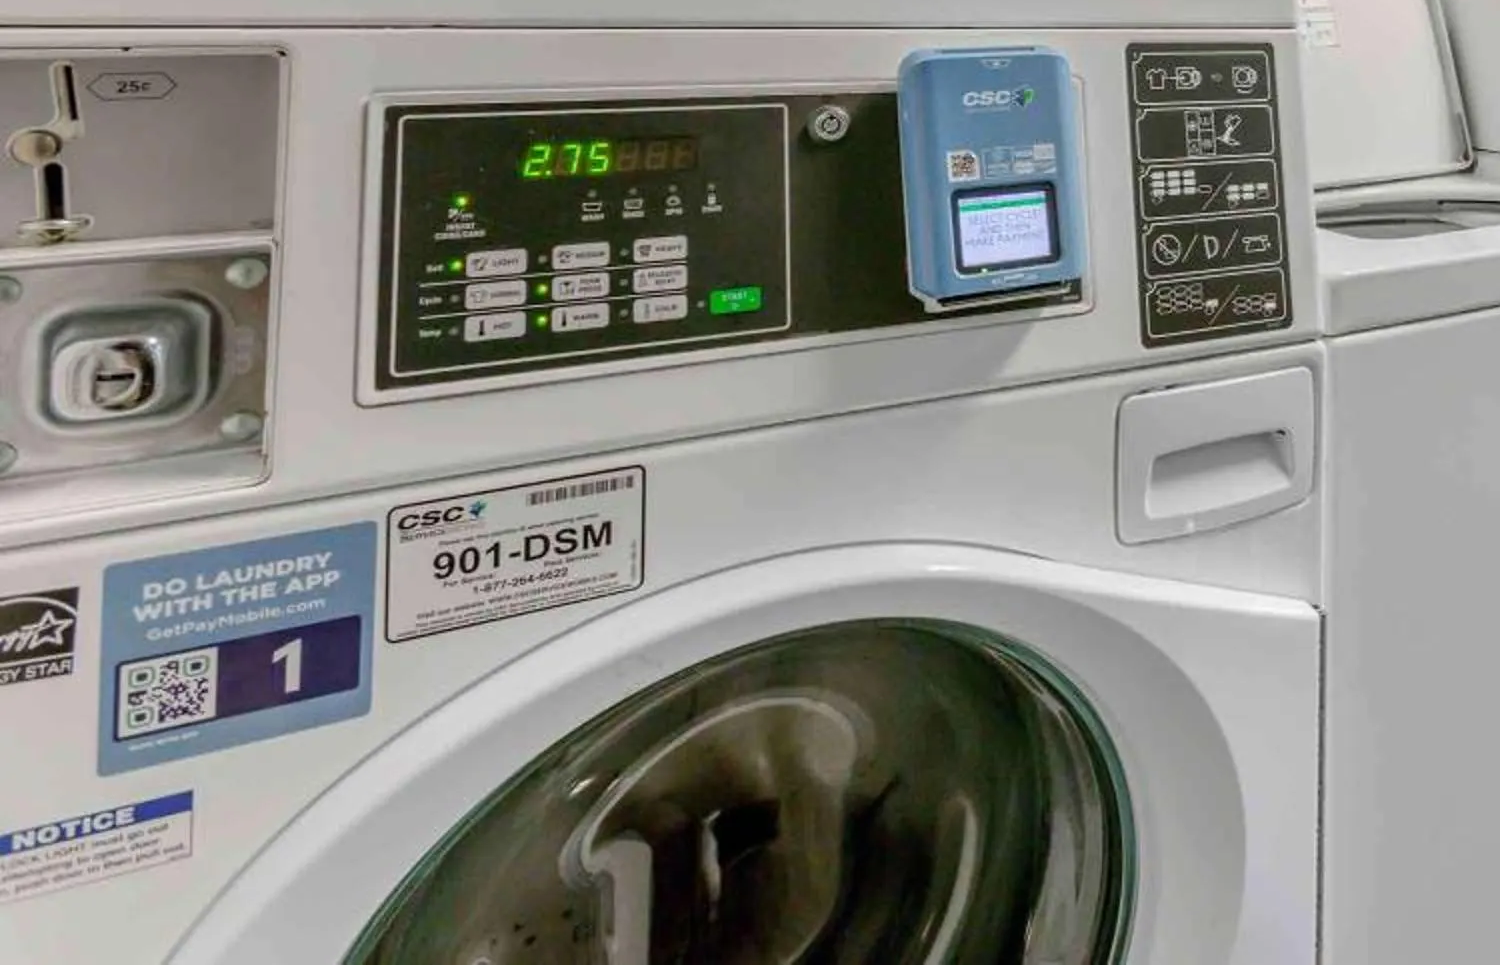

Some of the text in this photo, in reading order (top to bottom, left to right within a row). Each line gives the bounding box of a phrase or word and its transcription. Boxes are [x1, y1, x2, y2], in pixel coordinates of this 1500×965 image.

[963, 90, 1010, 106] CSC
[523, 142, 609, 177] 2.75
[397, 506, 465, 530] CSC
[433, 520, 613, 580] 901-DSM
[132, 569, 341, 623] WITH THE APP
[142, 551, 334, 602] DO LAUNDRY
[146, 597, 327, 642] GetPayMobile.com
[25, 659, 72, 679] STAR
[271, 638, 303, 695] 1
[12, 806, 135, 851] NOTICE
